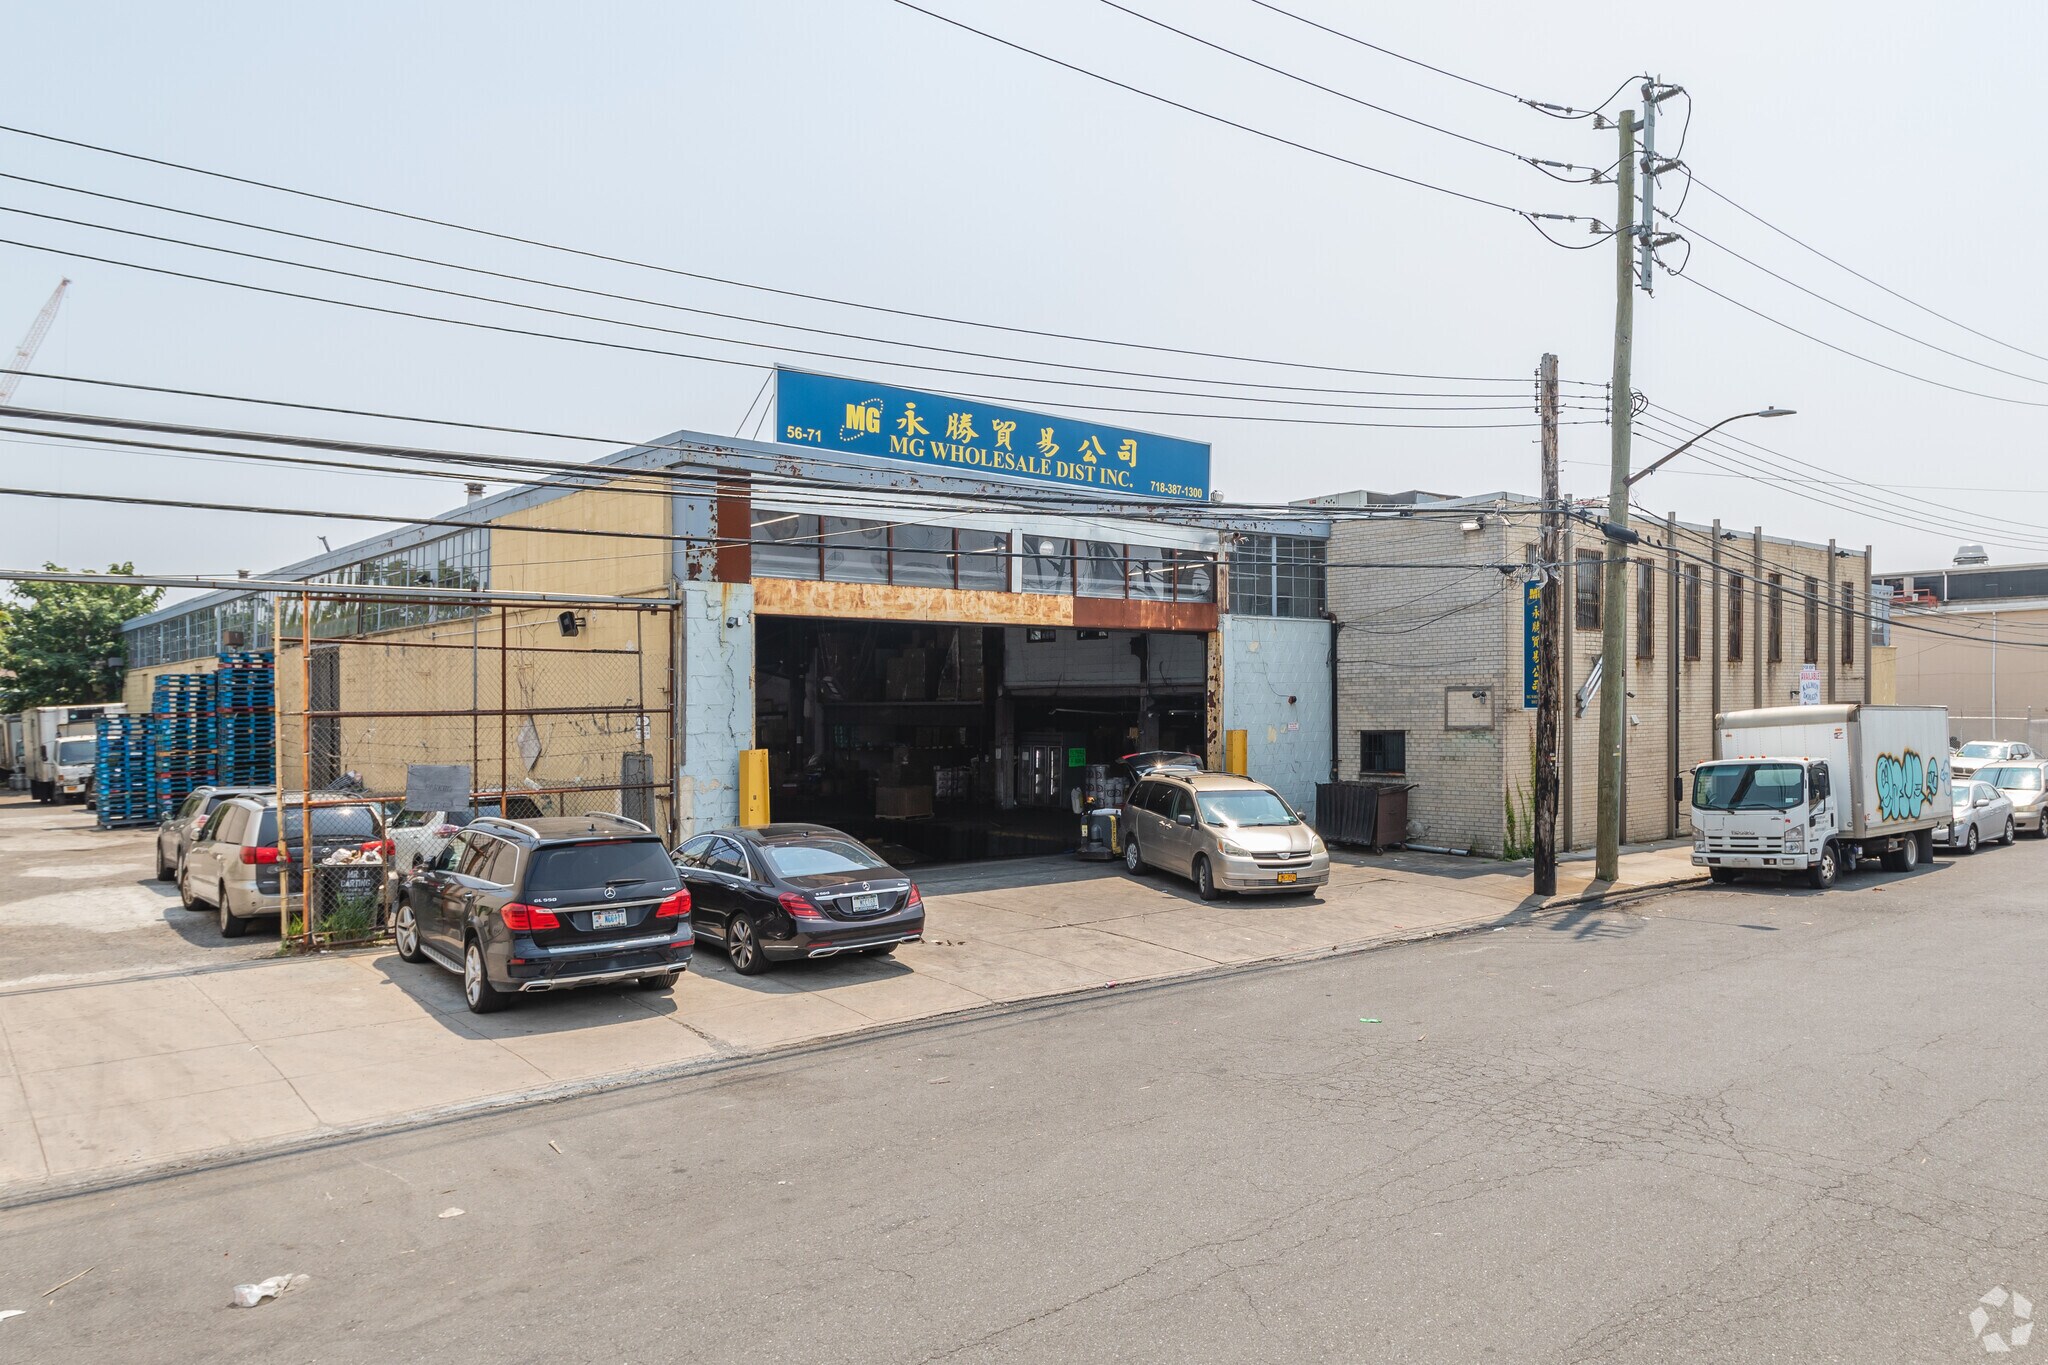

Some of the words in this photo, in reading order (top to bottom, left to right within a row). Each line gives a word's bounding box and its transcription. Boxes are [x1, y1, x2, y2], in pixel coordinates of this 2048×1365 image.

[846, 403, 881, 434] MG
[787, 425, 821, 442] 56-71
[896, 402, 1137, 468] 永勝貿易公司
[889, 434, 926, 457] MG
[930, 441, 1052, 476] WHOLESALE
[1056, 461, 1096, 482] DIST
[1100, 467, 1134, 488] INC.
[1150, 481, 1203, 498] 718-387-1300
[1801, 672, 1820, 680] AVAILABLE
[347, 870, 359, 878] MR
[340, 879, 371, 887] CARTING
